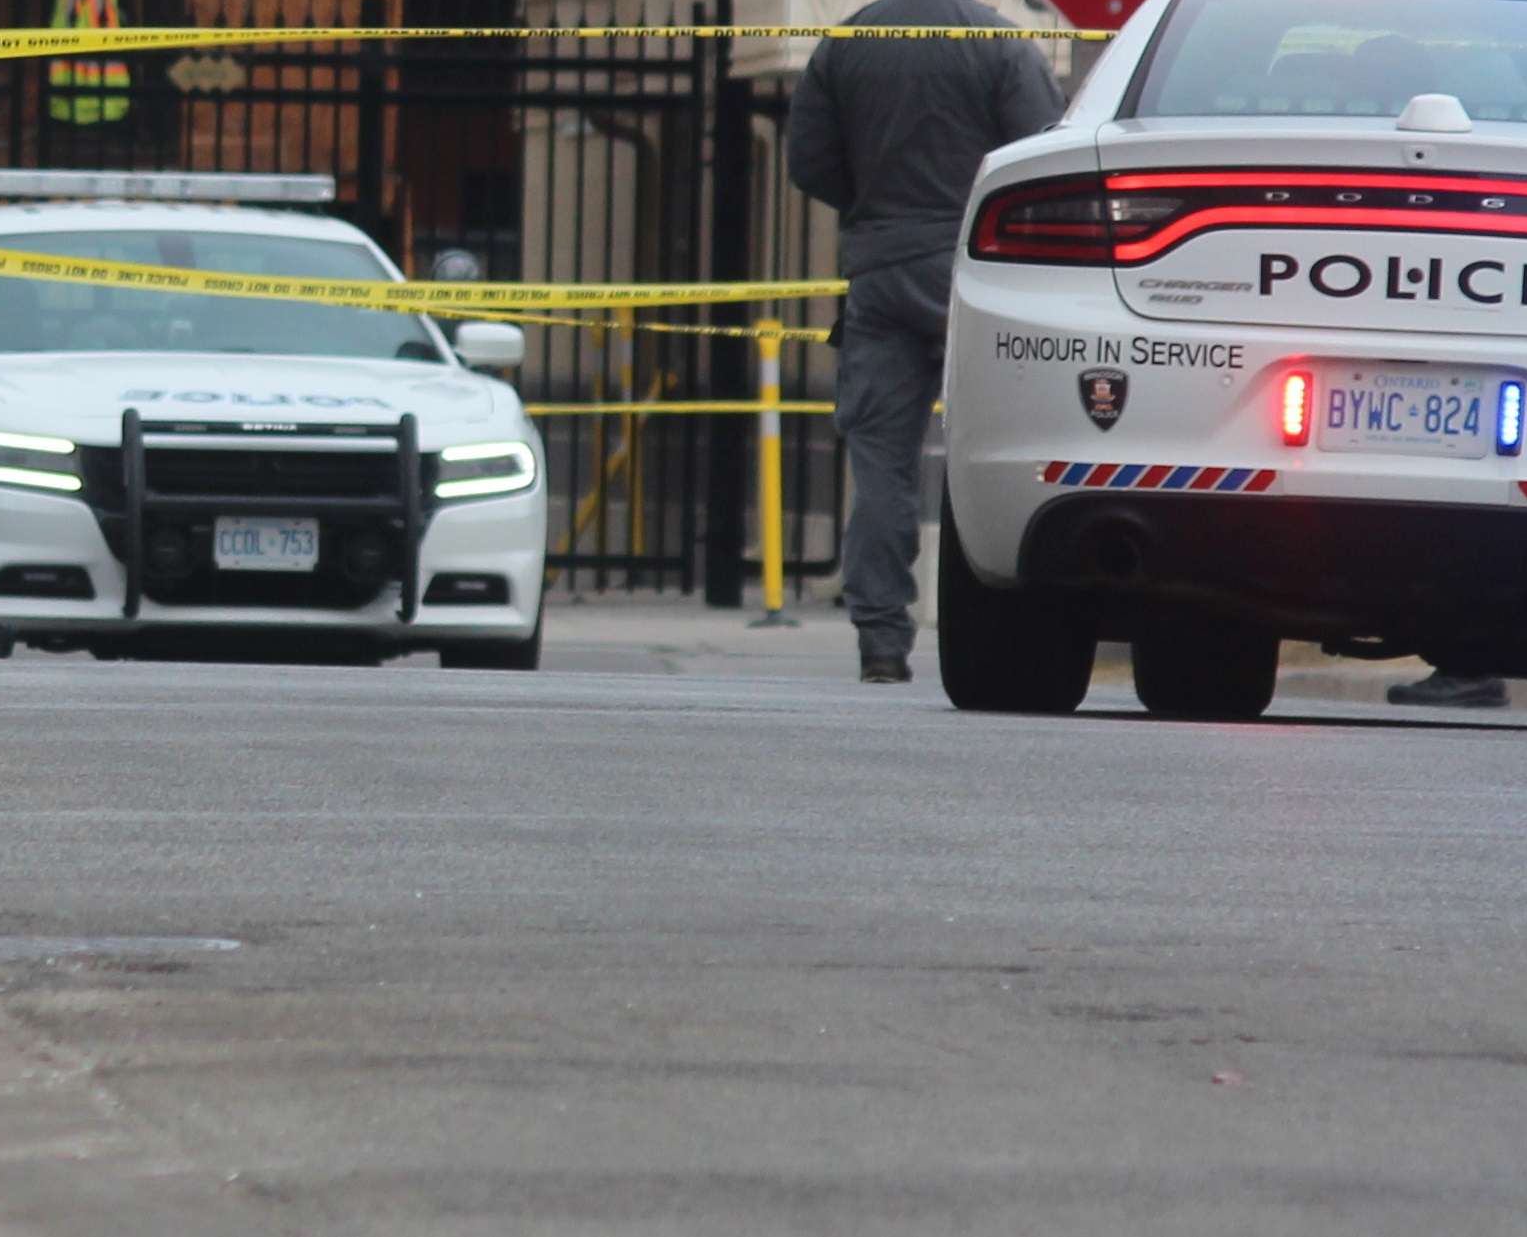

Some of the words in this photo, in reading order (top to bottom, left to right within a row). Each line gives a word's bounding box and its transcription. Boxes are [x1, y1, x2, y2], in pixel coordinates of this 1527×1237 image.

[1138, 278, 1253, 293] CHARGER
[996, 332, 1087, 363] HONOUR
[1097, 336, 1120, 364] IN
[1131, 336, 1244, 369] SERVICE
[1374, 373, 1441, 389] ONTARIO
